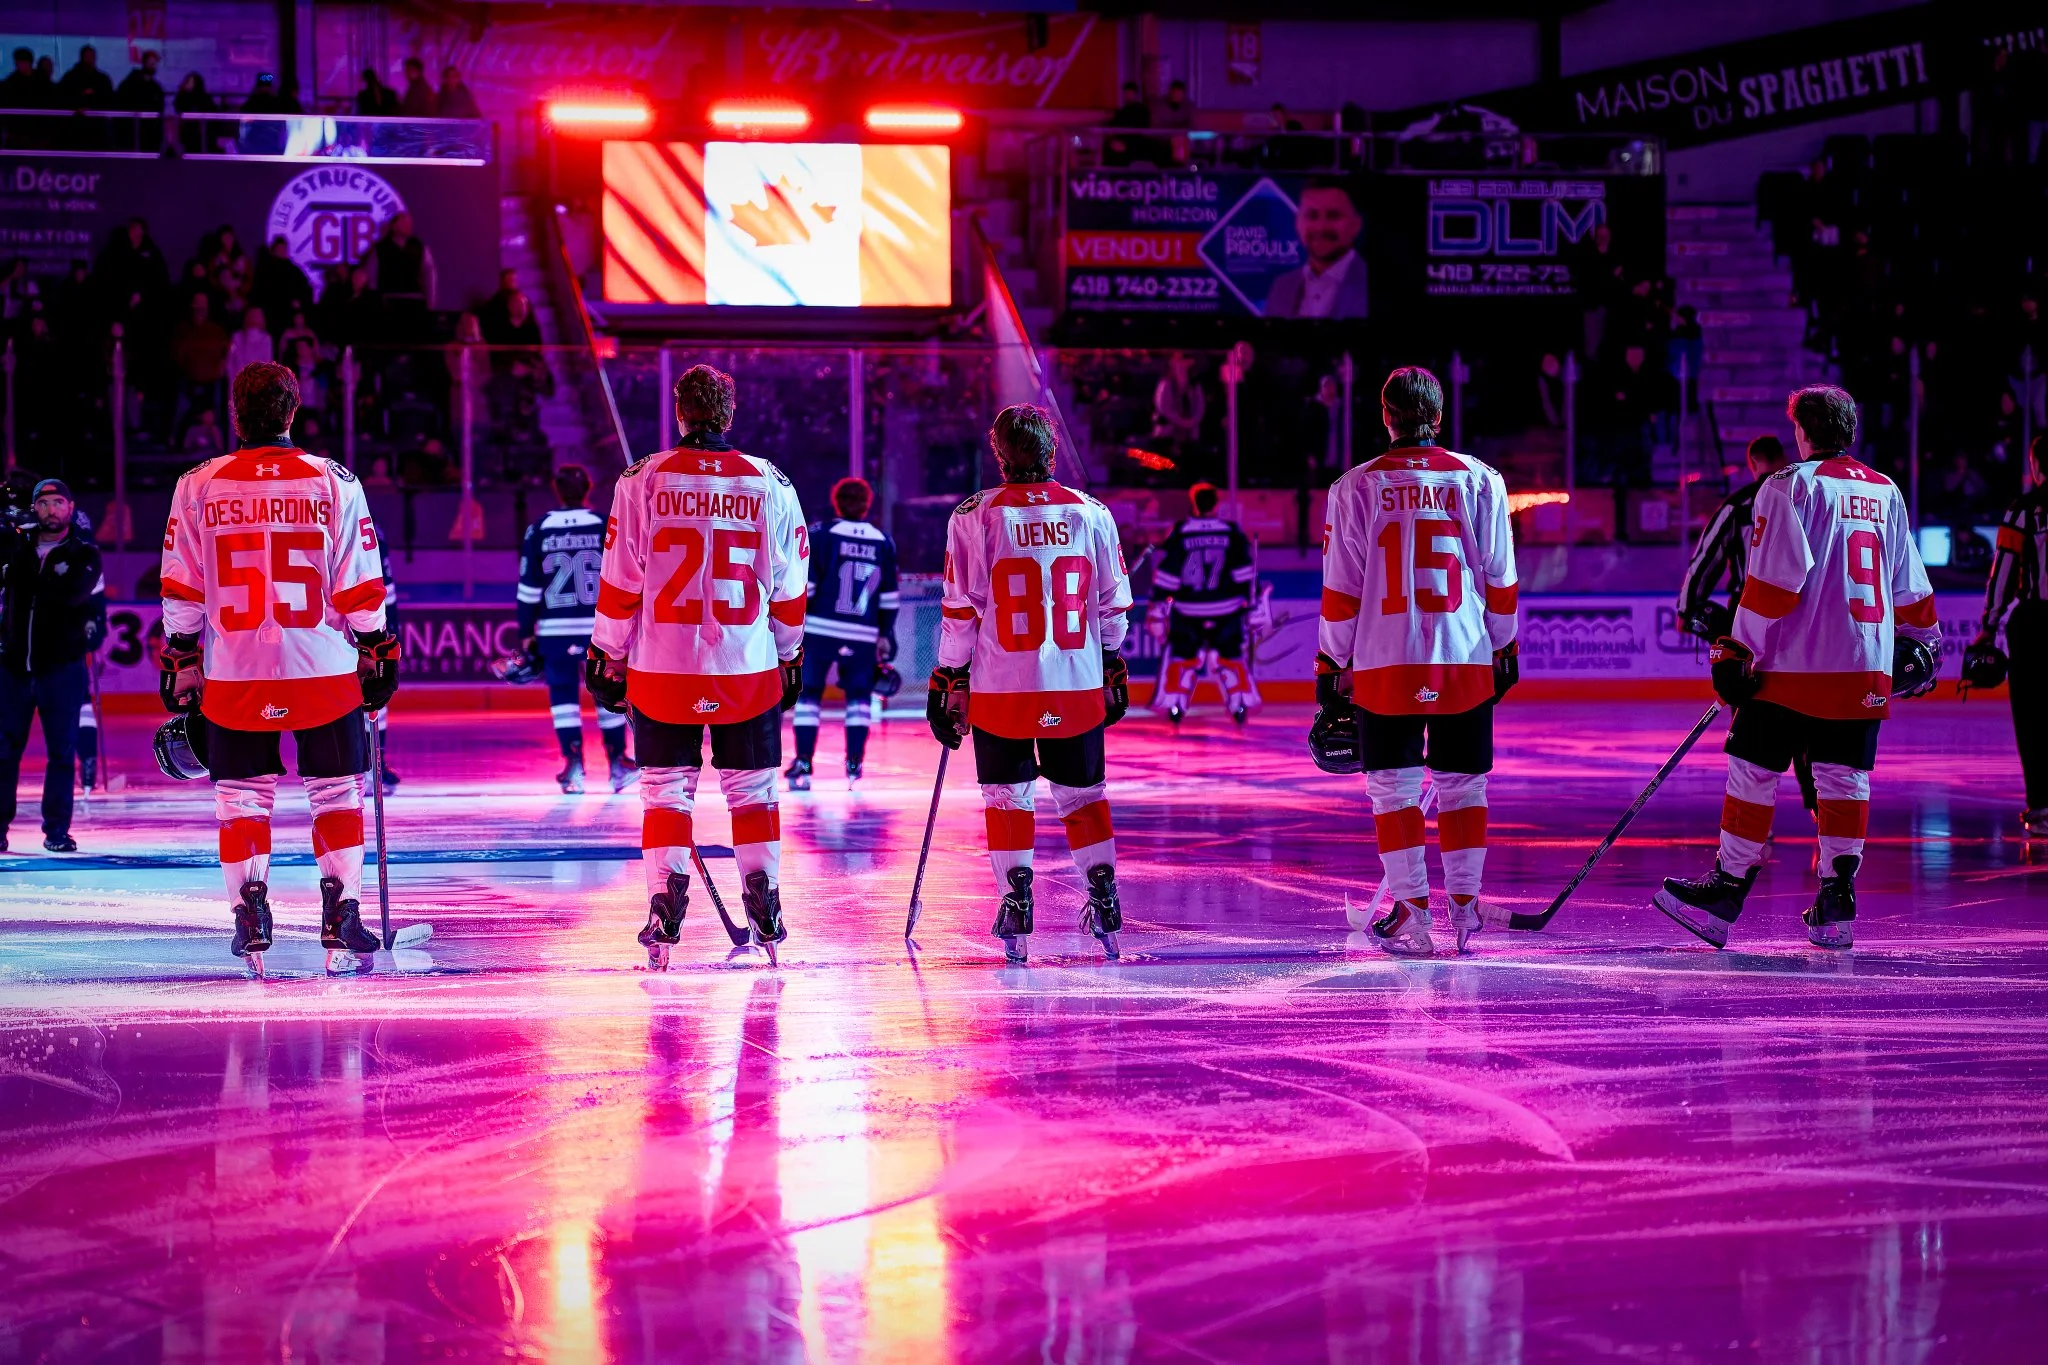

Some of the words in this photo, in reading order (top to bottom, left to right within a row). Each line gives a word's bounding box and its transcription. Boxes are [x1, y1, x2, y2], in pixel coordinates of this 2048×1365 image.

[1575, 61, 1729, 125] MAISON
[1738, 41, 1930, 120] SPAGHETTI
[1692, 100, 1733, 131] DU
[1131, 206, 1219, 223] HORIZON
[1427, 199, 1606, 256] DLM
[1070, 275, 1111, 297] 418
[1114, 275, 1220, 299] 740-2322
[204, 499, 331, 528] DESJARDINS
[656, 491, 761, 523] OVCHAROV
[1381, 485, 1457, 513] STRAKA
[1840, 495, 1885, 524] LEBEL
[1016, 521, 1069, 548] UENS
[215, 531, 325, 632] 55
[541, 551, 603, 609] 26
[652, 526, 762, 626] 25
[834, 560, 881, 616] 17
[1181, 550, 1226, 592] 47
[1377, 518, 1464, 616] 15
[1846, 530, 1885, 624] 9
[991, 555, 1093, 653] 88
